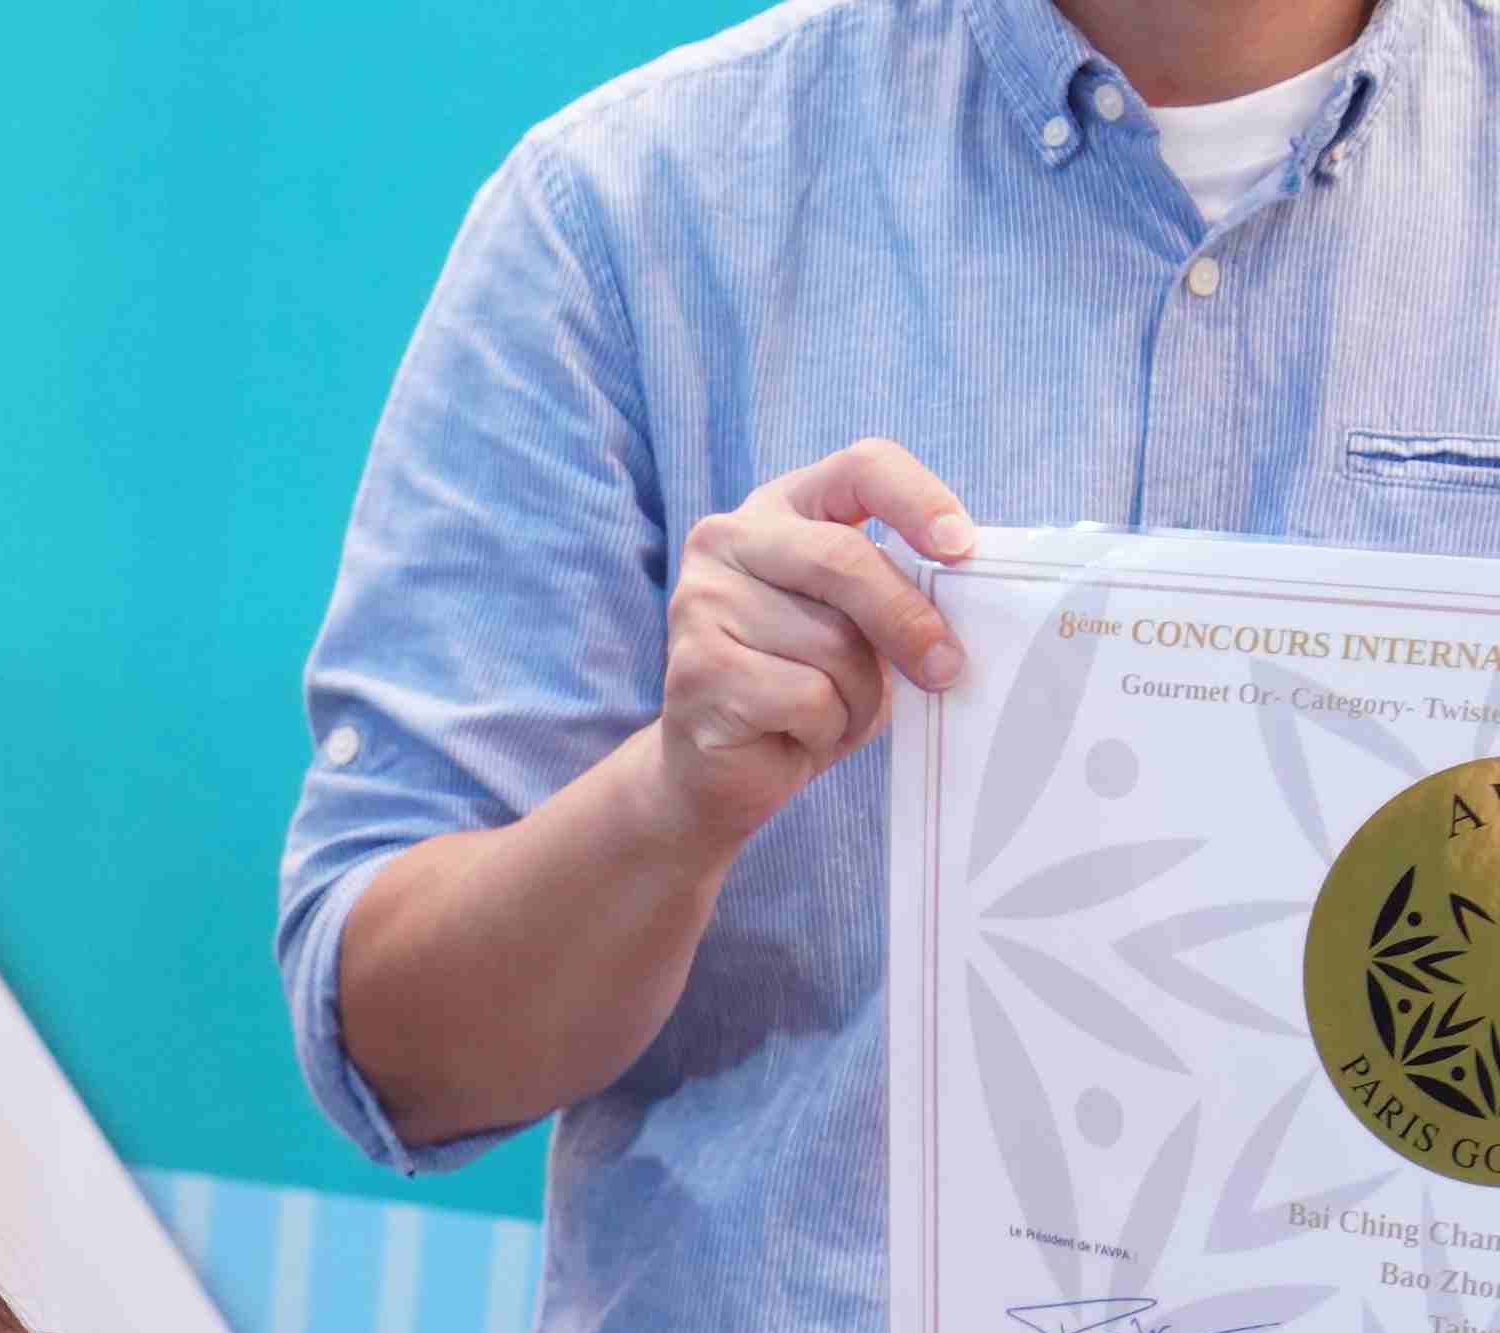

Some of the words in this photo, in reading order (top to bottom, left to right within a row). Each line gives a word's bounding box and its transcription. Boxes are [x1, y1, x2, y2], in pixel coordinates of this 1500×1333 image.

[1131, 618, 1331, 659] CONCOURS
[1121, 673, 1230, 704] Gourmet
[1448, 783, 1500, 839] A
[1340, 1053, 1440, 1152] PARIS
[1287, 1201, 1331, 1230] Bai
[1339, 1210, 1421, 1249] Ching
[1379, 1260, 1432, 1290] Bao
